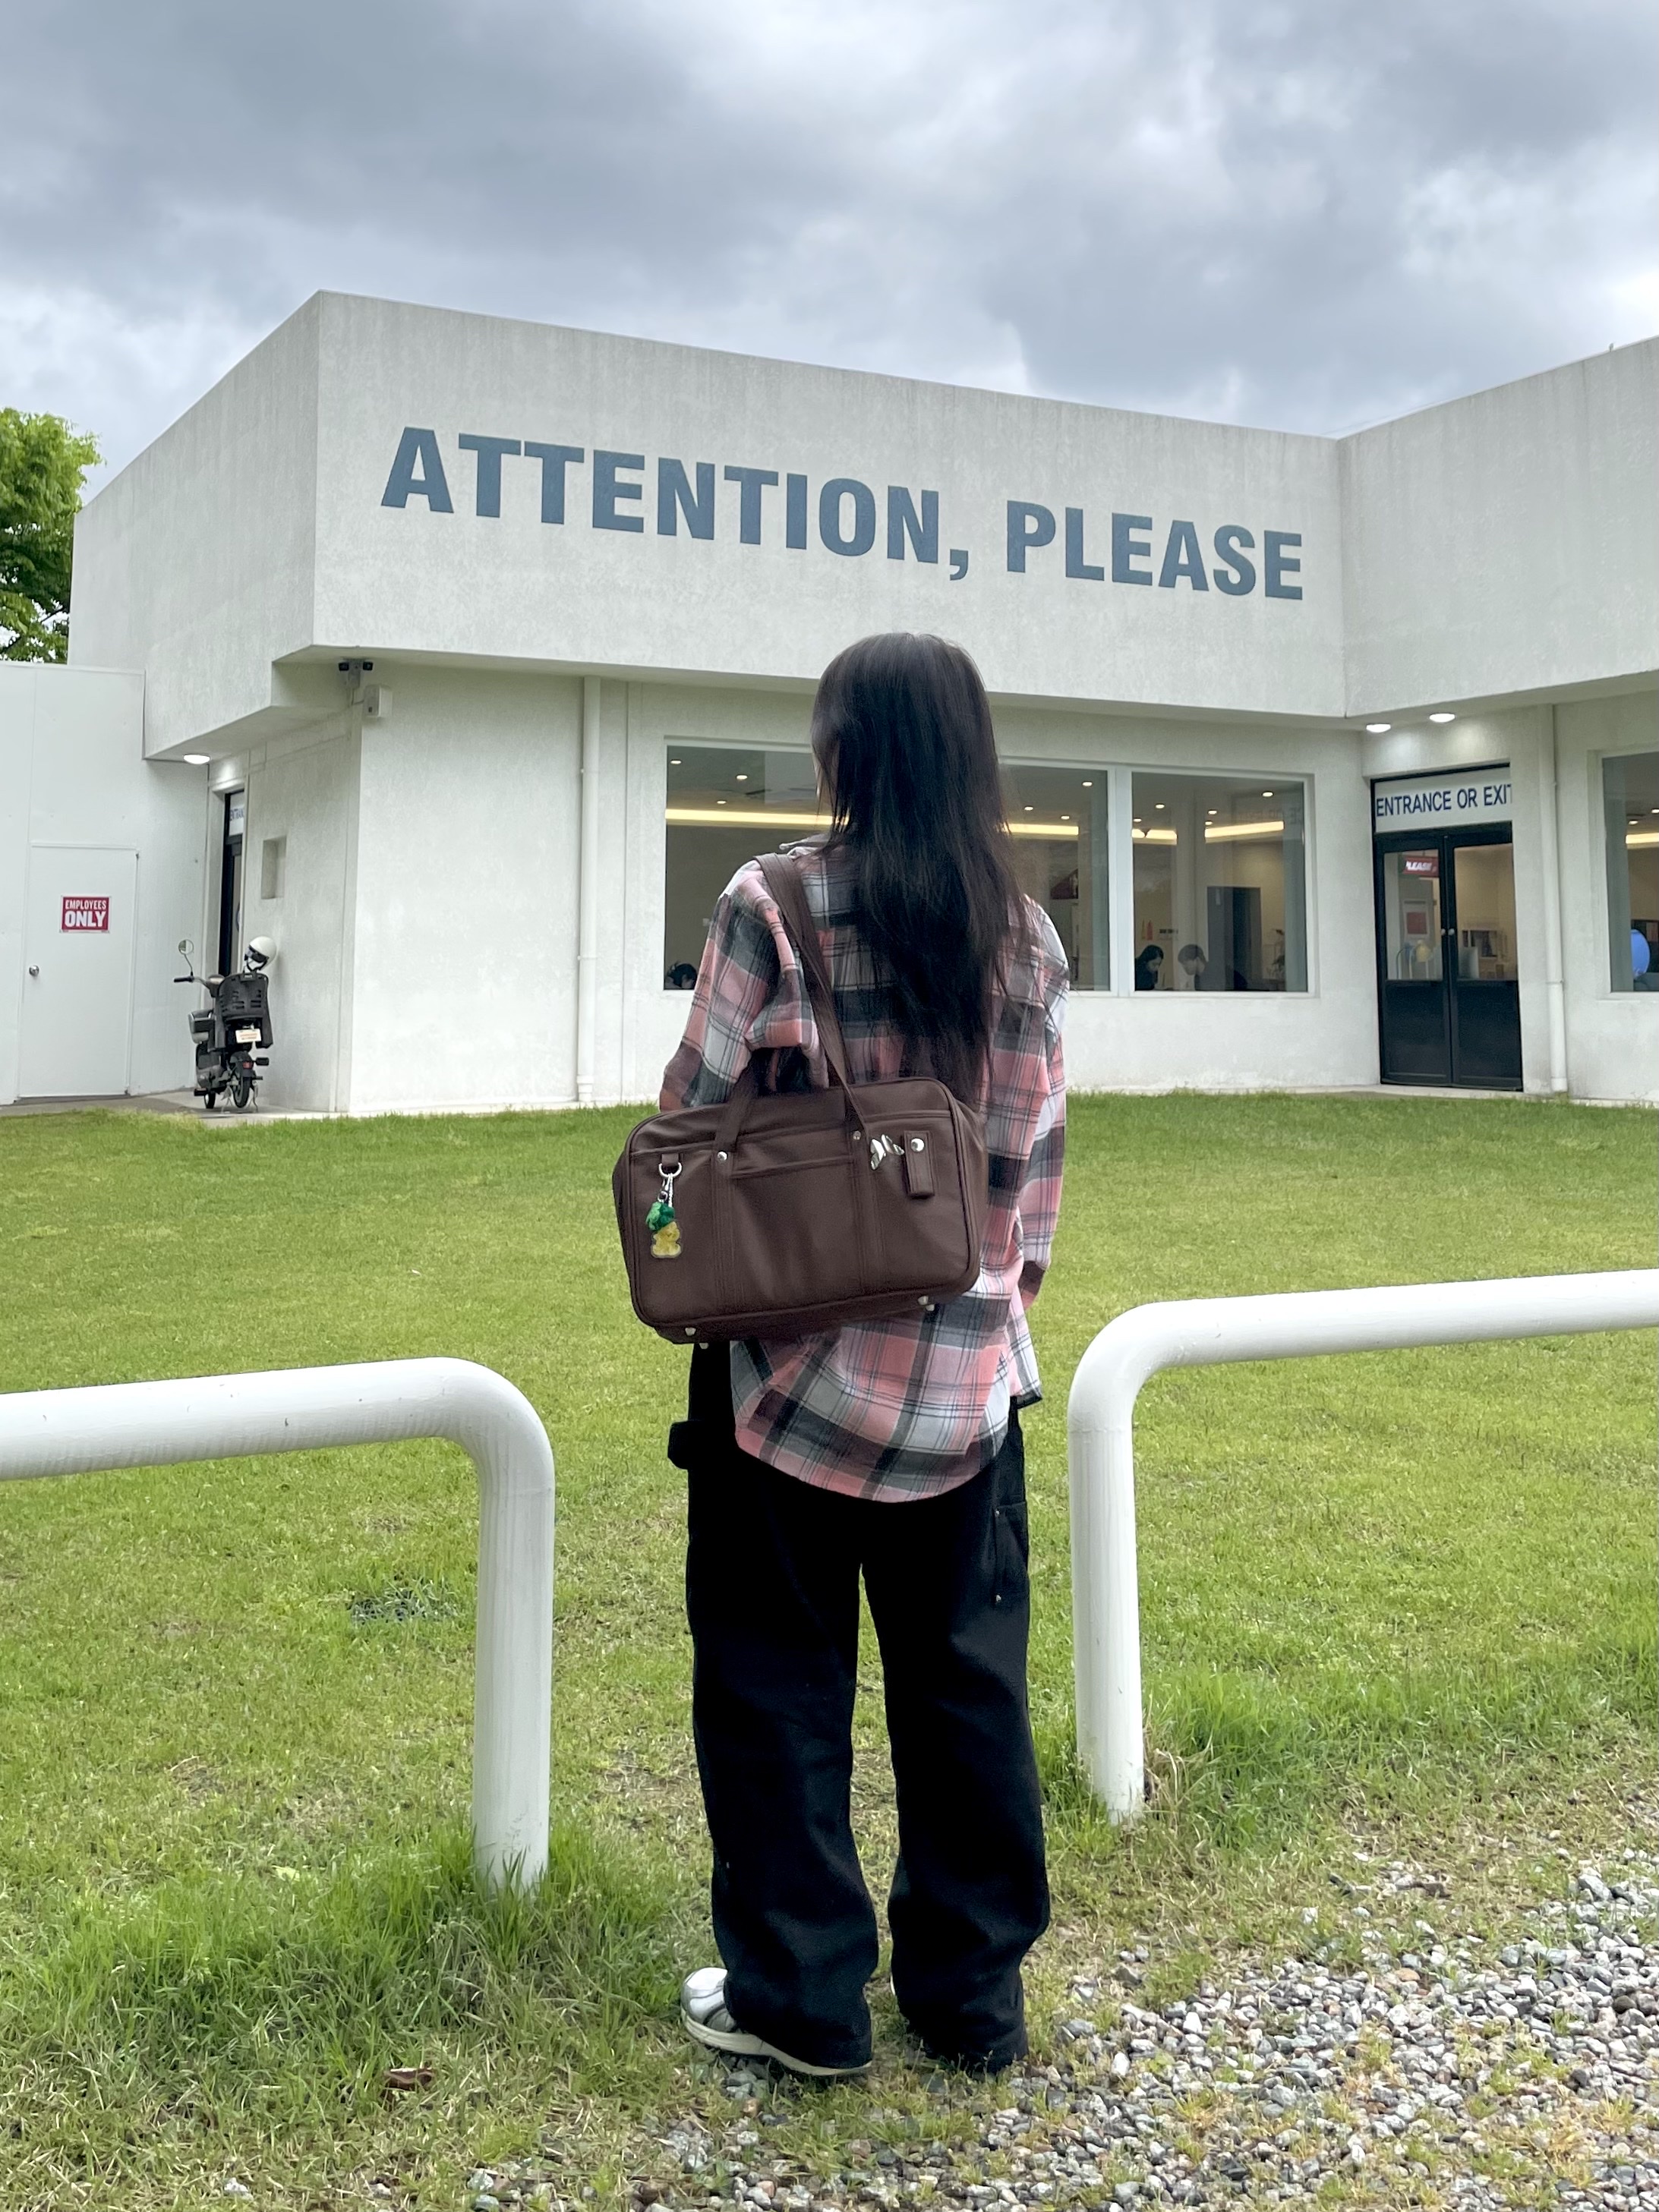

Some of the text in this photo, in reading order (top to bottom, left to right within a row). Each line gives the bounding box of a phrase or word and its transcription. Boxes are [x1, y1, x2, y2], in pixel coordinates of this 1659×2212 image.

[380, 427, 1303, 600] ATTENTION, PLEASE
[1376, 790, 1452, 817] ENTRANCE
[1457, 788, 1478, 809] OR
[65, 900, 106, 910] EMPLOYEES
[65, 910, 106, 928] ONLY
